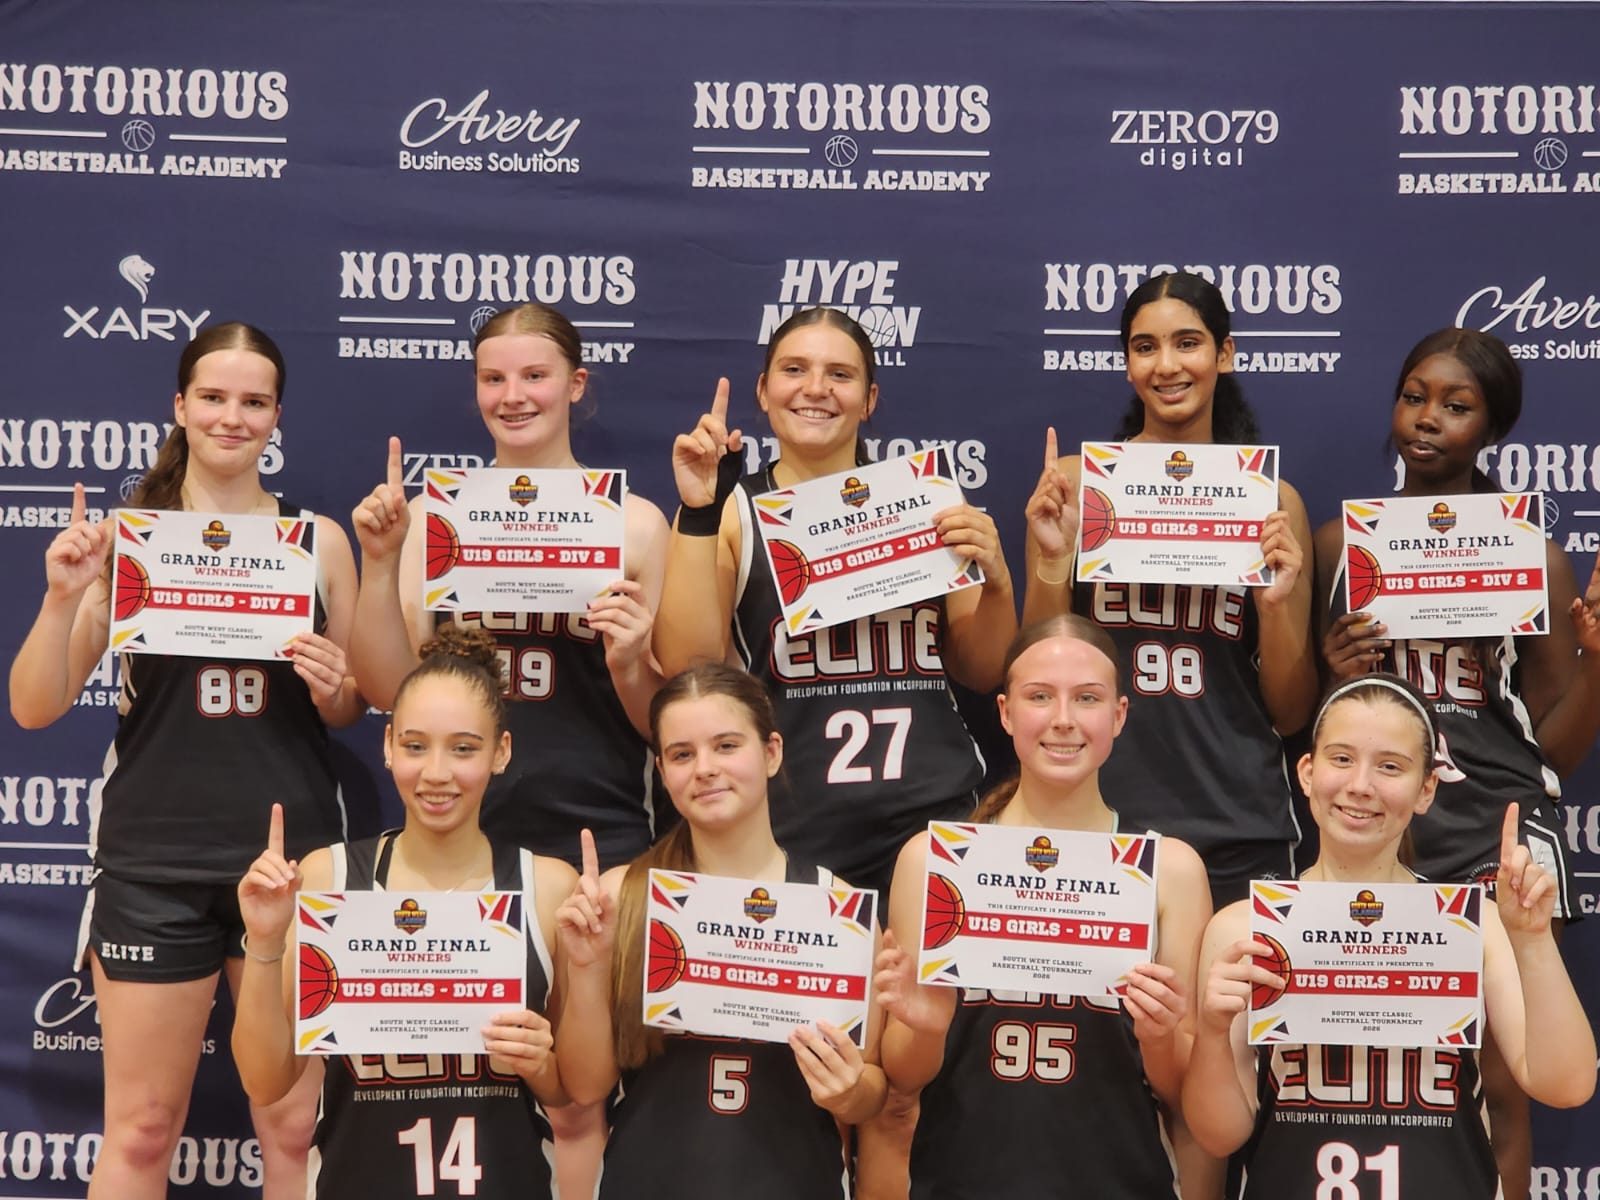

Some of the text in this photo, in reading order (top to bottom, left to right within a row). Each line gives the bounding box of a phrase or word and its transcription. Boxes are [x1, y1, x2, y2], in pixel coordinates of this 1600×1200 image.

[0, 64, 288, 120] NOTORIOUS
[694, 81, 991, 133] NOTORIOUS
[1400, 85, 1600, 134] NOTORI
[400, 89, 580, 156] Avery
[1110, 110, 1279, 144] ZERO79
[0, 150, 287, 178] ASKETBALL ACADEMY
[400, 151, 580, 173] Business Solutions
[1140, 148, 1243, 170] digital
[692, 168, 990, 191] BASKETBALL ACADEMY
[1399, 173, 1567, 194] BASKETBALL
[340, 251, 636, 305] NOTORIOUS
[778, 259, 899, 305] HYPE
[1044, 263, 1342, 314] NOTIOUS
[1455, 276, 1600, 333] Aver
[64, 306, 210, 341] XARY
[339, 338, 474, 360] BASKETBA
[1544, 340, 1600, 360] Soluti
[1043, 350, 1341, 373] BASKE CADEMY
[1124, 484, 1246, 497] GRAND FINAL
[1158, 497, 1213, 506] WINNERS
[468, 510, 593, 523] GRAND FINAL
[807, 510, 868, 536] GRAND
[874, 493, 931, 518] FINAL
[844, 514, 900, 536] WINNERS
[502, 523, 558, 531] WINNERS
[1118, 521, 1147, 534] U19
[1151, 522, 1197, 535] GIRLS
[1213, 523, 1243, 536] DIV
[1247, 524, 1257, 537] 2
[812, 557, 844, 577] U19
[845, 543, 894, 568] GIRLS
[907, 530, 939, 551] DIV
[1388, 535, 1513, 550] GRAND FINAL
[1423, 548, 1479, 558] WINNERS
[160, 552, 285, 570] GRAND FINAL
[462, 548, 492, 561] U19
[496, 549, 543, 562] GIRLS
[559, 550, 590, 563] DIV
[594, 550, 605, 563] 2
[194, 566, 250, 578] WINNERS
[1384, 576, 1414, 590] U19
[1418, 574, 1466, 589] GIRLS
[1481, 573, 1512, 586] DIV
[1516, 572, 1528, 585] 2
[152, 590, 182, 604] U19
[186, 592, 234, 607] GIRLS
[250, 596, 280, 610] DIV
[284, 597, 295, 611] 2
[771, 604, 945, 682] ELITE
[1135, 642, 1203, 697] 98
[198, 667, 266, 717] 88
[786, 684, 837, 699] DEVELOPMENT
[840, 680, 890, 695] FOUNDATION
[825, 707, 912, 784] 27
[976, 872, 1120, 895] GRAND FINAL
[1015, 889, 1080, 903] WINNERS
[696, 921, 838, 948] GRAND FINAL
[967, 915, 1001, 932] U19
[1005, 918, 1060, 937] GIRLS
[1078, 924, 1114, 941] DIV
[1118, 926, 1131, 942] 2
[1302, 930, 1447, 945] GRAND FINAL
[102, 942, 154, 961] ELITE
[347, 938, 490, 952] GRAND FINAL
[734, 938, 798, 954] WINNERS
[1341, 944, 1407, 954] WINNERS
[387, 953, 451, 962] WINNERS
[992, 962, 1092, 974] BASKETBALL TOURNAMENT
[688, 962, 721, 980] U19
[725, 967, 779, 986] GIRLS
[796, 975, 832, 992] DIV
[836, 979, 849, 994] 2
[1294, 973, 1328, 988] U19
[1333, 974, 1389, 989] GIRLS
[1407, 975, 1442, 990] DIV
[1447, 976, 1460, 990] 2
[342, 982, 375, 997] U19
[380, 982, 434, 997] GIRLS
[453, 982, 487, 997] DIV
[492, 983, 504, 997] 2
[33, 1030, 103, 1051] Busine
[993, 1022, 1075, 1082] 95
[710, 1056, 750, 1113] 5
[1270, 1044, 1458, 1108] ELITE
[354, 1089, 405, 1102] DEVELOPMENT
[409, 1087, 461, 1099] FOUNDATION
[1275, 1111, 1453, 1127] DEVELOPMENT FOUNDATION INCORPORATED
[0, 1131, 263, 1187] OTOOUS
[398, 1116, 482, 1196] 14
[1316, 1141, 1400, 1200] 81
